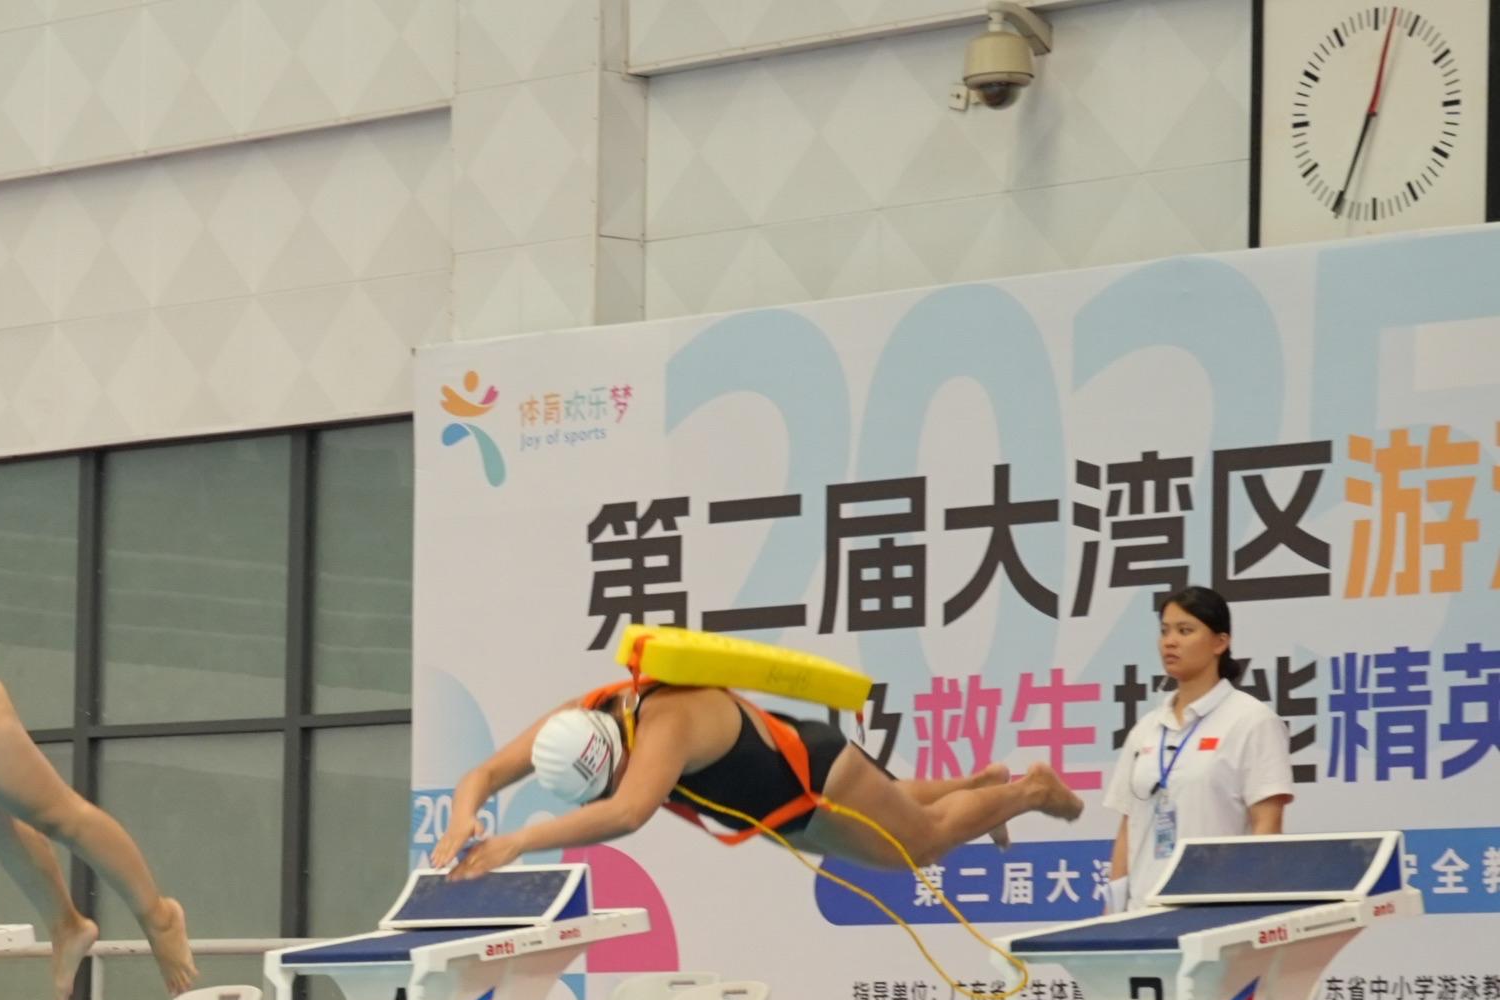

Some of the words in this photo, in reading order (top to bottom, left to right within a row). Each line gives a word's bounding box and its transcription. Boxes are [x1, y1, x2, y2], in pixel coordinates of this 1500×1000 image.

[519, 384, 632, 426] 体育欢乐梦
[546, 430, 560, 445] of
[564, 428, 607, 446] sports
[586, 421, 1500, 651] 第二届大湾区游
[414, 795, 495, 843] 205
[485, 941, 515, 956] anti
[559, 927, 581, 940] anti
[1258, 925, 1288, 944] anti
[1373, 903, 1395, 917] anti
